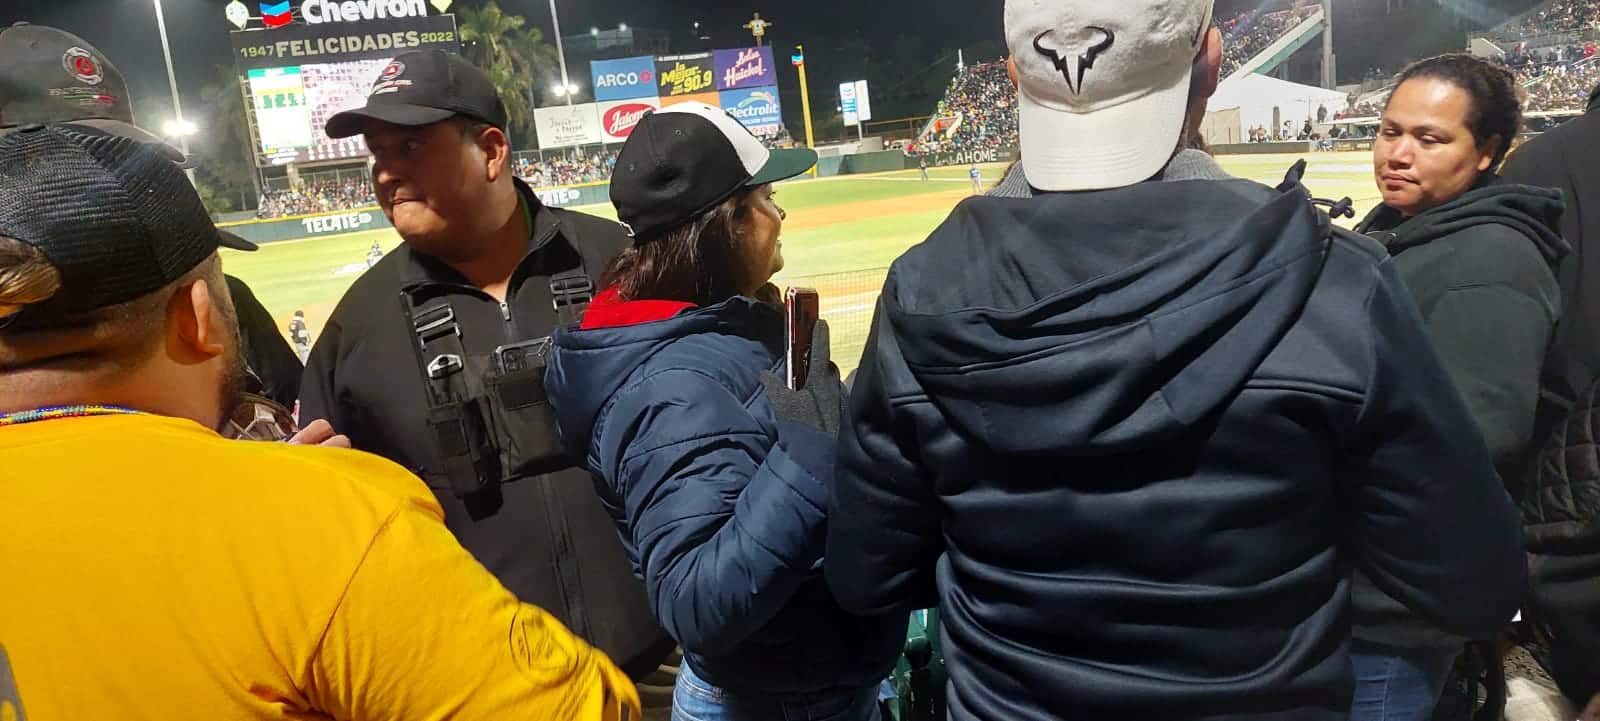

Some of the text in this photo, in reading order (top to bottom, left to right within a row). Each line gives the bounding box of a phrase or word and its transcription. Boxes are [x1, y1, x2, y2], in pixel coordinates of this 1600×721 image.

[301, 0, 427, 24] Chevron
[241, 31, 454, 58] 1947 FELICIDADES 2022
[596, 72, 638, 88] ARCO
[683, 70, 713, 92] 90.9
[302, 215, 360, 234] TECATE
